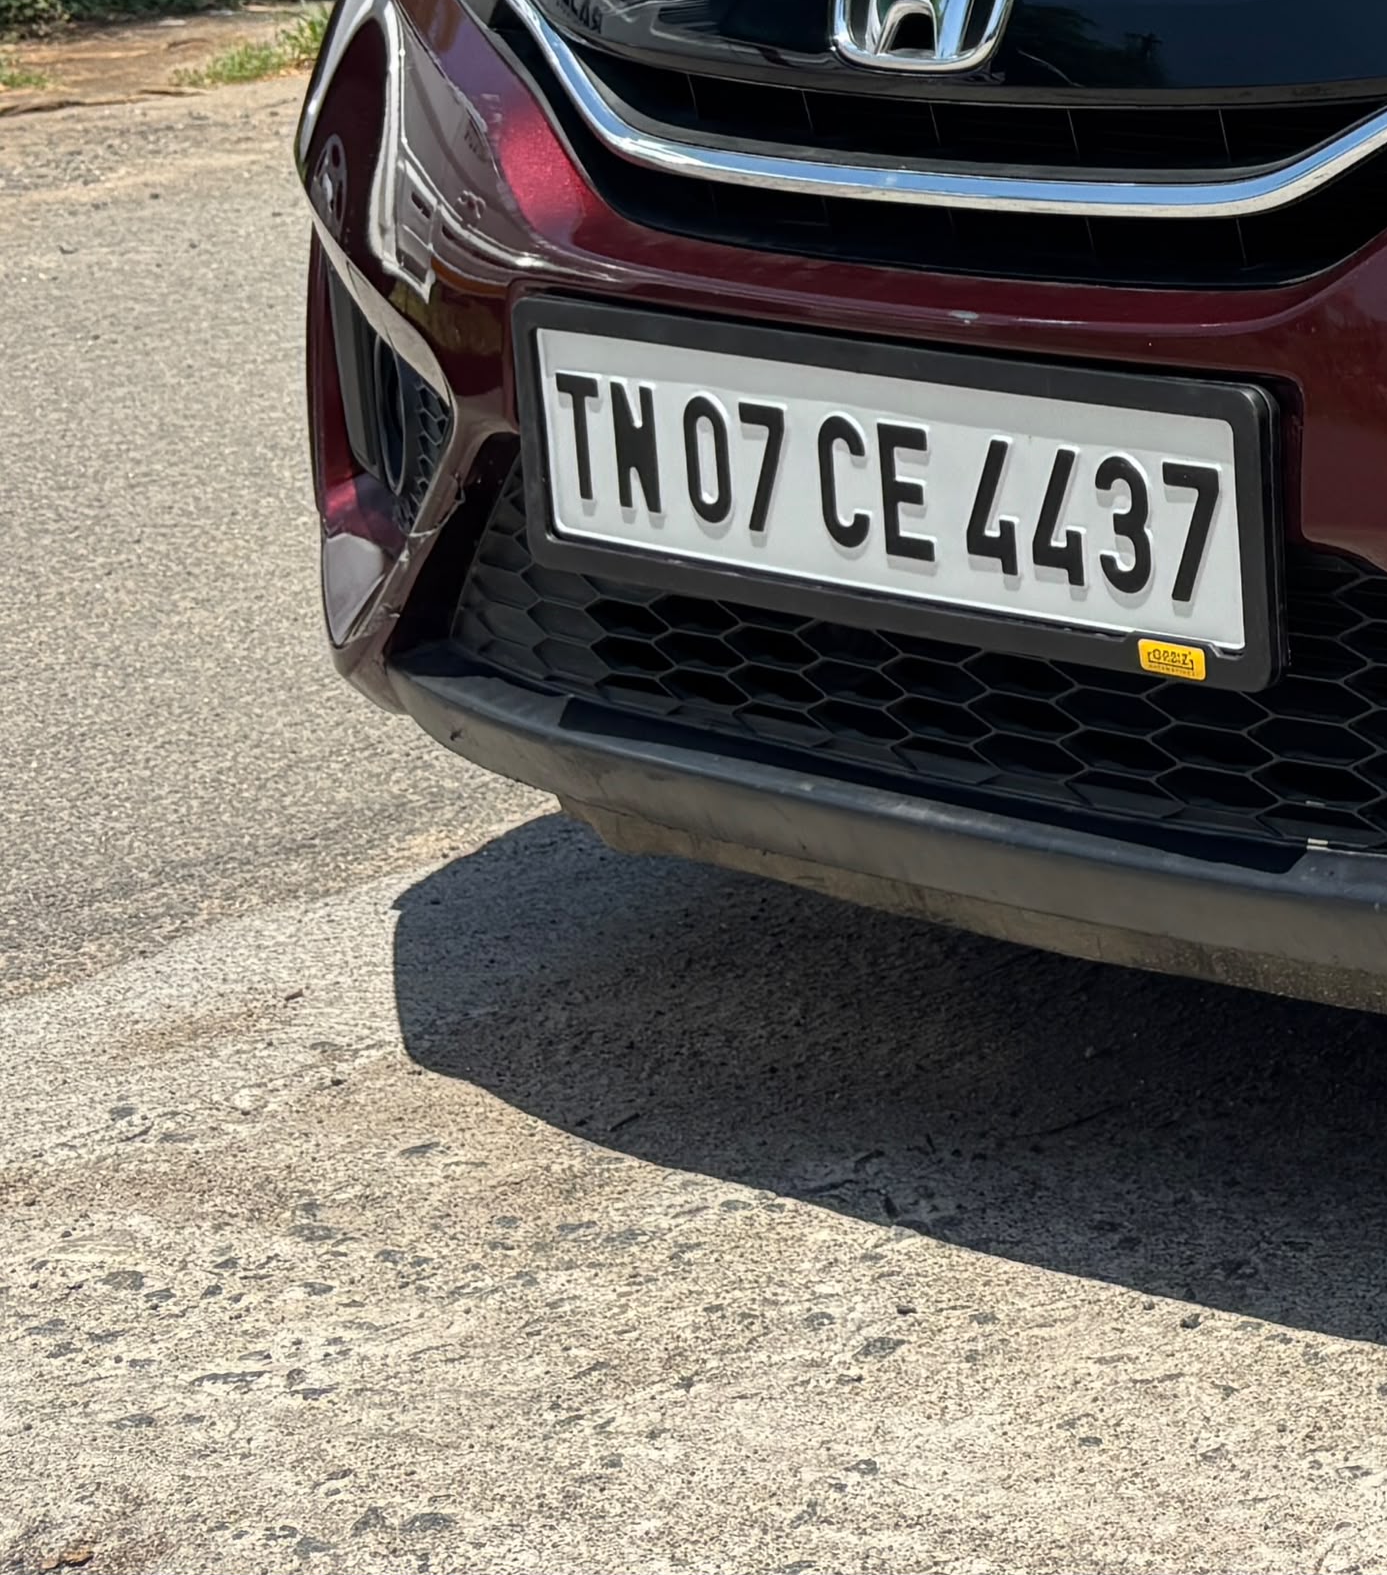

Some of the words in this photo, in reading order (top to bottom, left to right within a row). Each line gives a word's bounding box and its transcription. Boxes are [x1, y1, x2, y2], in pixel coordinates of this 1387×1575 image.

[555, 371, 662, 514] TN
[683, 395, 786, 533] 07
[816, 415, 936, 563] CE
[965, 438, 1221, 603] 4437
